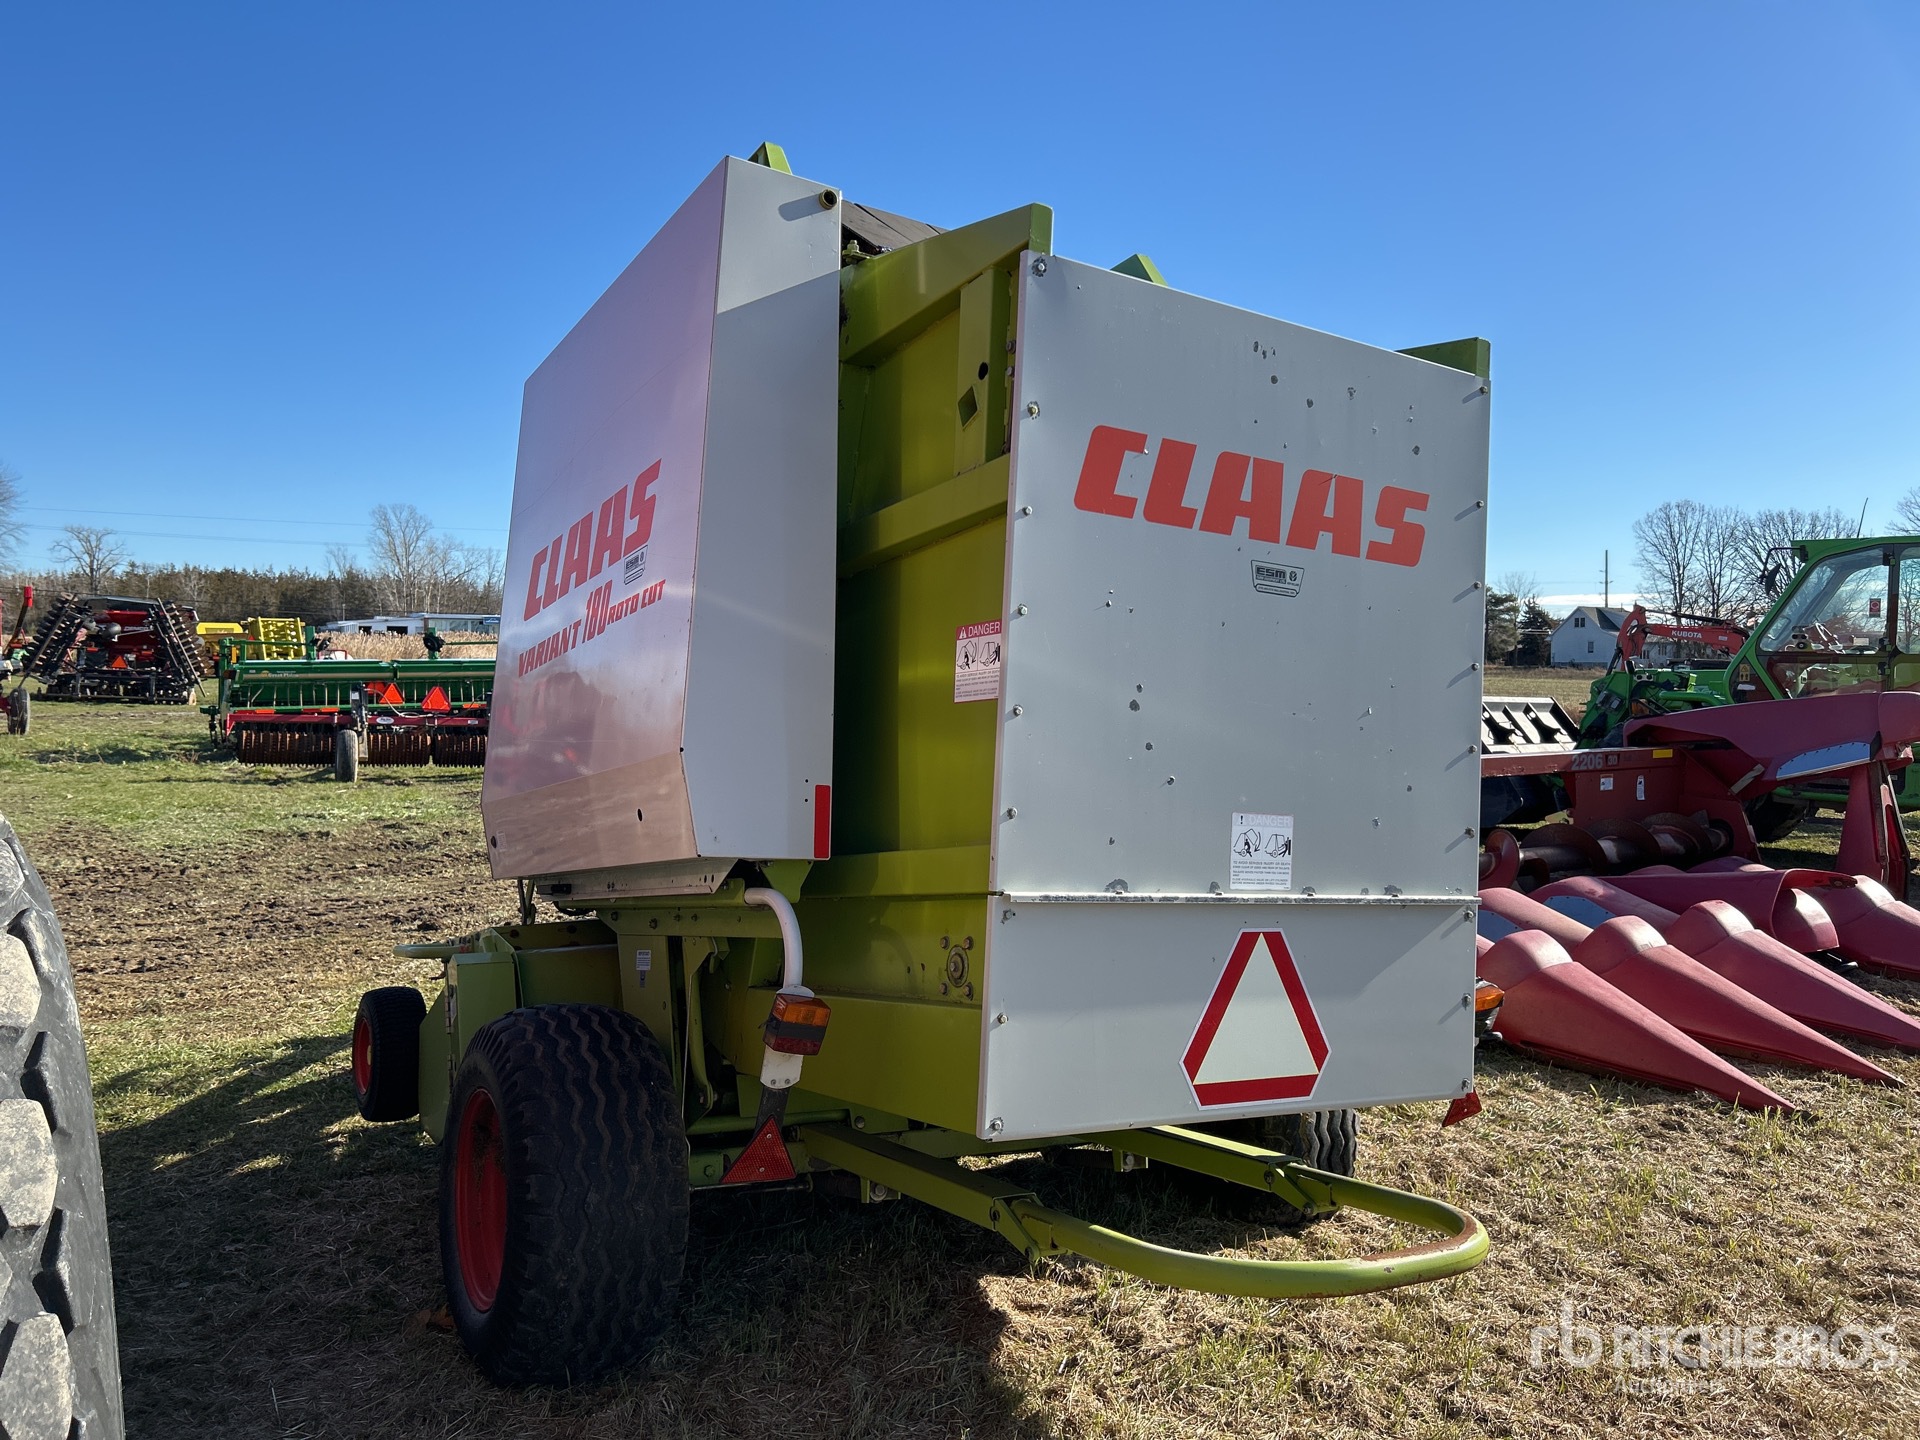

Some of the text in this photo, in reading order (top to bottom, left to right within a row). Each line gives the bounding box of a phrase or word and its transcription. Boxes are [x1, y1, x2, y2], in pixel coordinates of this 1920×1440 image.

[1073, 424, 1431, 568] CLAAS
[524, 458, 662, 621] CLAAS
[1256, 566, 1286, 579] ESM
[518, 579, 667, 679] VARIANT 180 ROTO CUT
[968, 621, 1001, 637] DANGER
[1671, 630, 1702, 639] KUBOTA
[1571, 754, 1617, 771] 2206 30
[1250, 815, 1290, 827] DANGER
